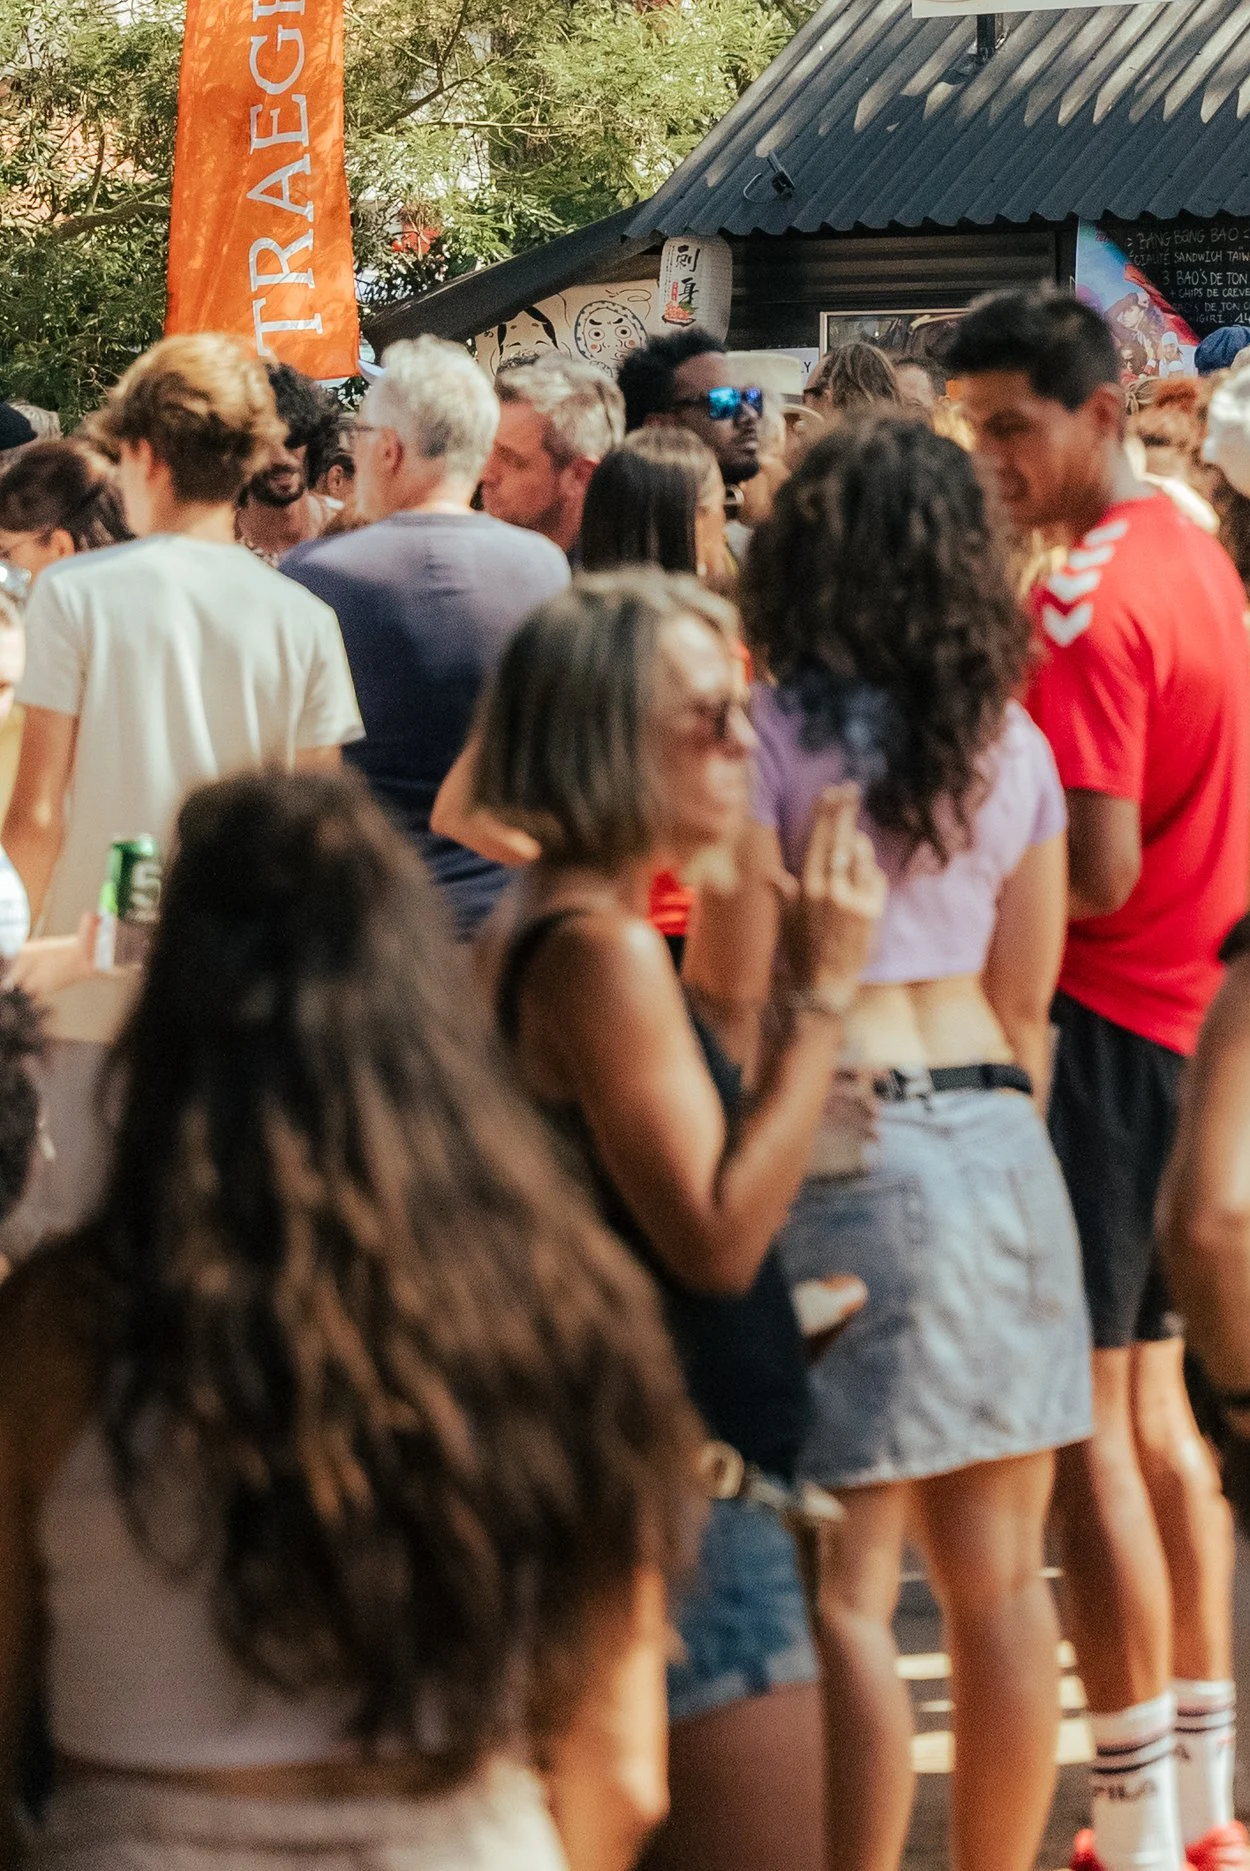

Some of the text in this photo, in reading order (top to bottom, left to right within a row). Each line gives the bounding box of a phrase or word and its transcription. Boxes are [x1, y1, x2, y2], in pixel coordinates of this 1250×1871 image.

[1210, 227, 1239, 242] BAO
[1174, 248, 1223, 263] SANDWICH
[1209, 272, 1223, 286] DE
[1226, 272, 1248, 286] TON
[1178, 288, 1203, 299] CHIPS
[1206, 288, 1218, 298] DE
[1204, 302, 1216, 313] DE
[1220, 301, 1240, 312] TON
